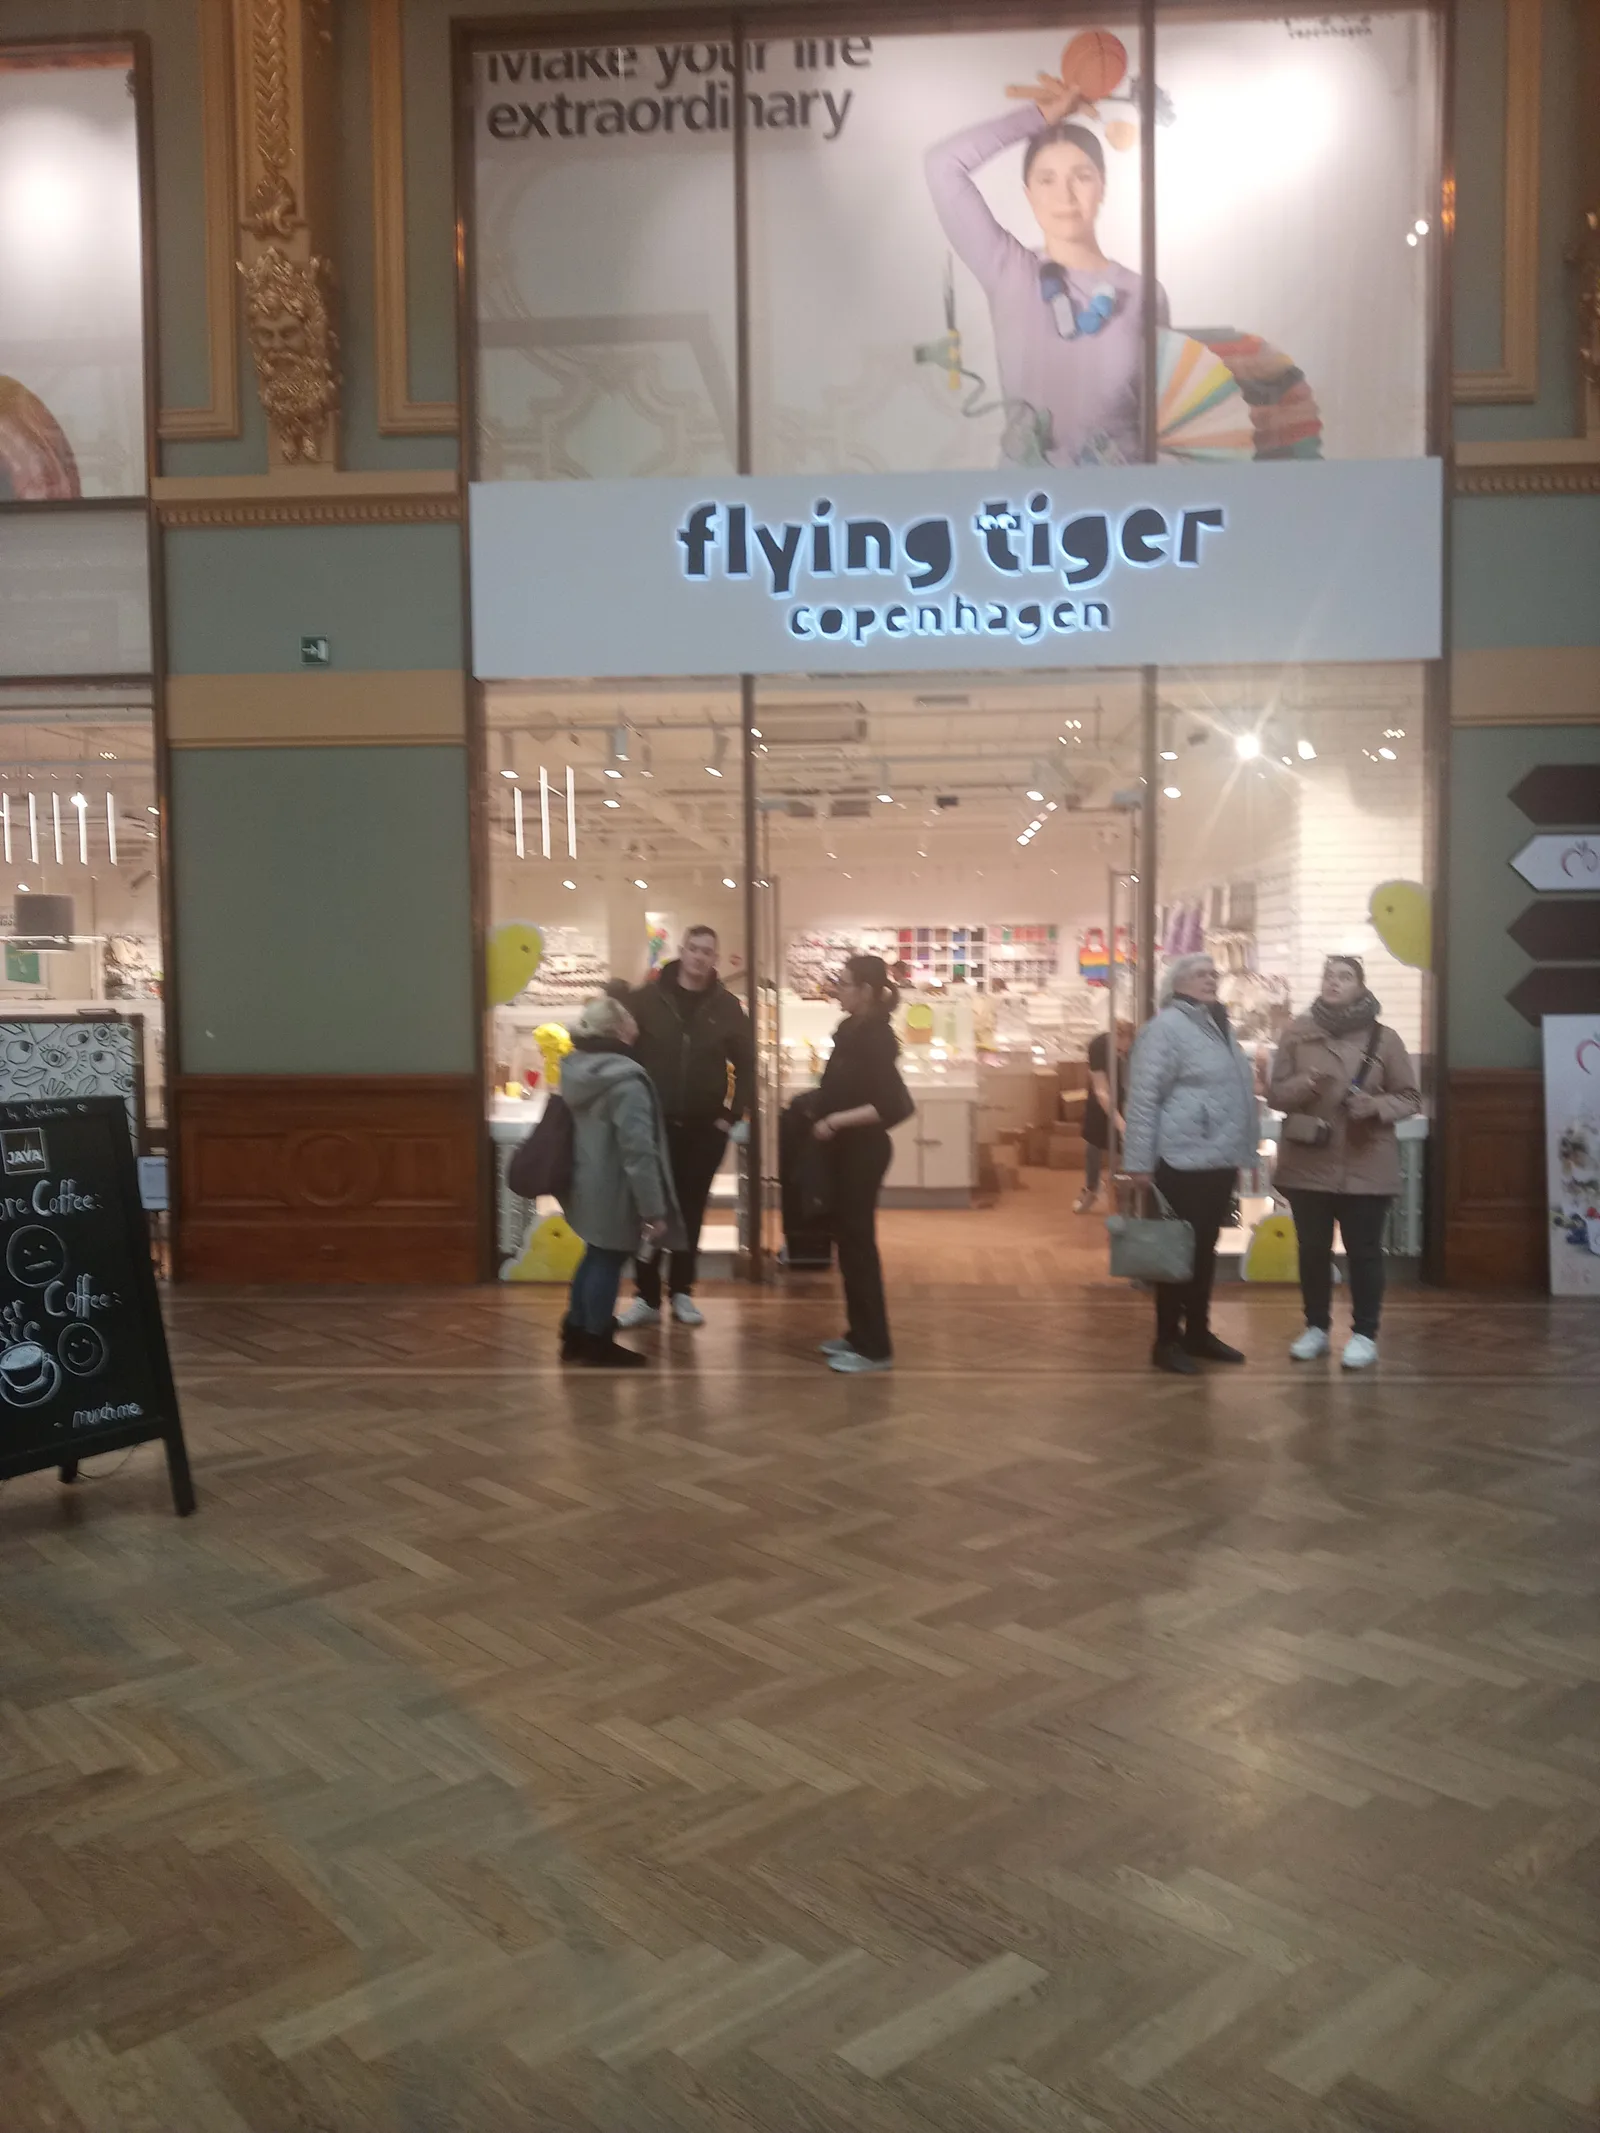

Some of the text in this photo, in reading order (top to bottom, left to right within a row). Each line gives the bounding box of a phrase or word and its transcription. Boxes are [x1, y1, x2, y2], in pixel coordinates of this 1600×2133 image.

[486, 80, 854, 140] extraordinary
[677, 490, 1228, 598] flying tiger
[787, 593, 1111, 645] copenhagen
[6, 1149, 44, 1165] JAVA
